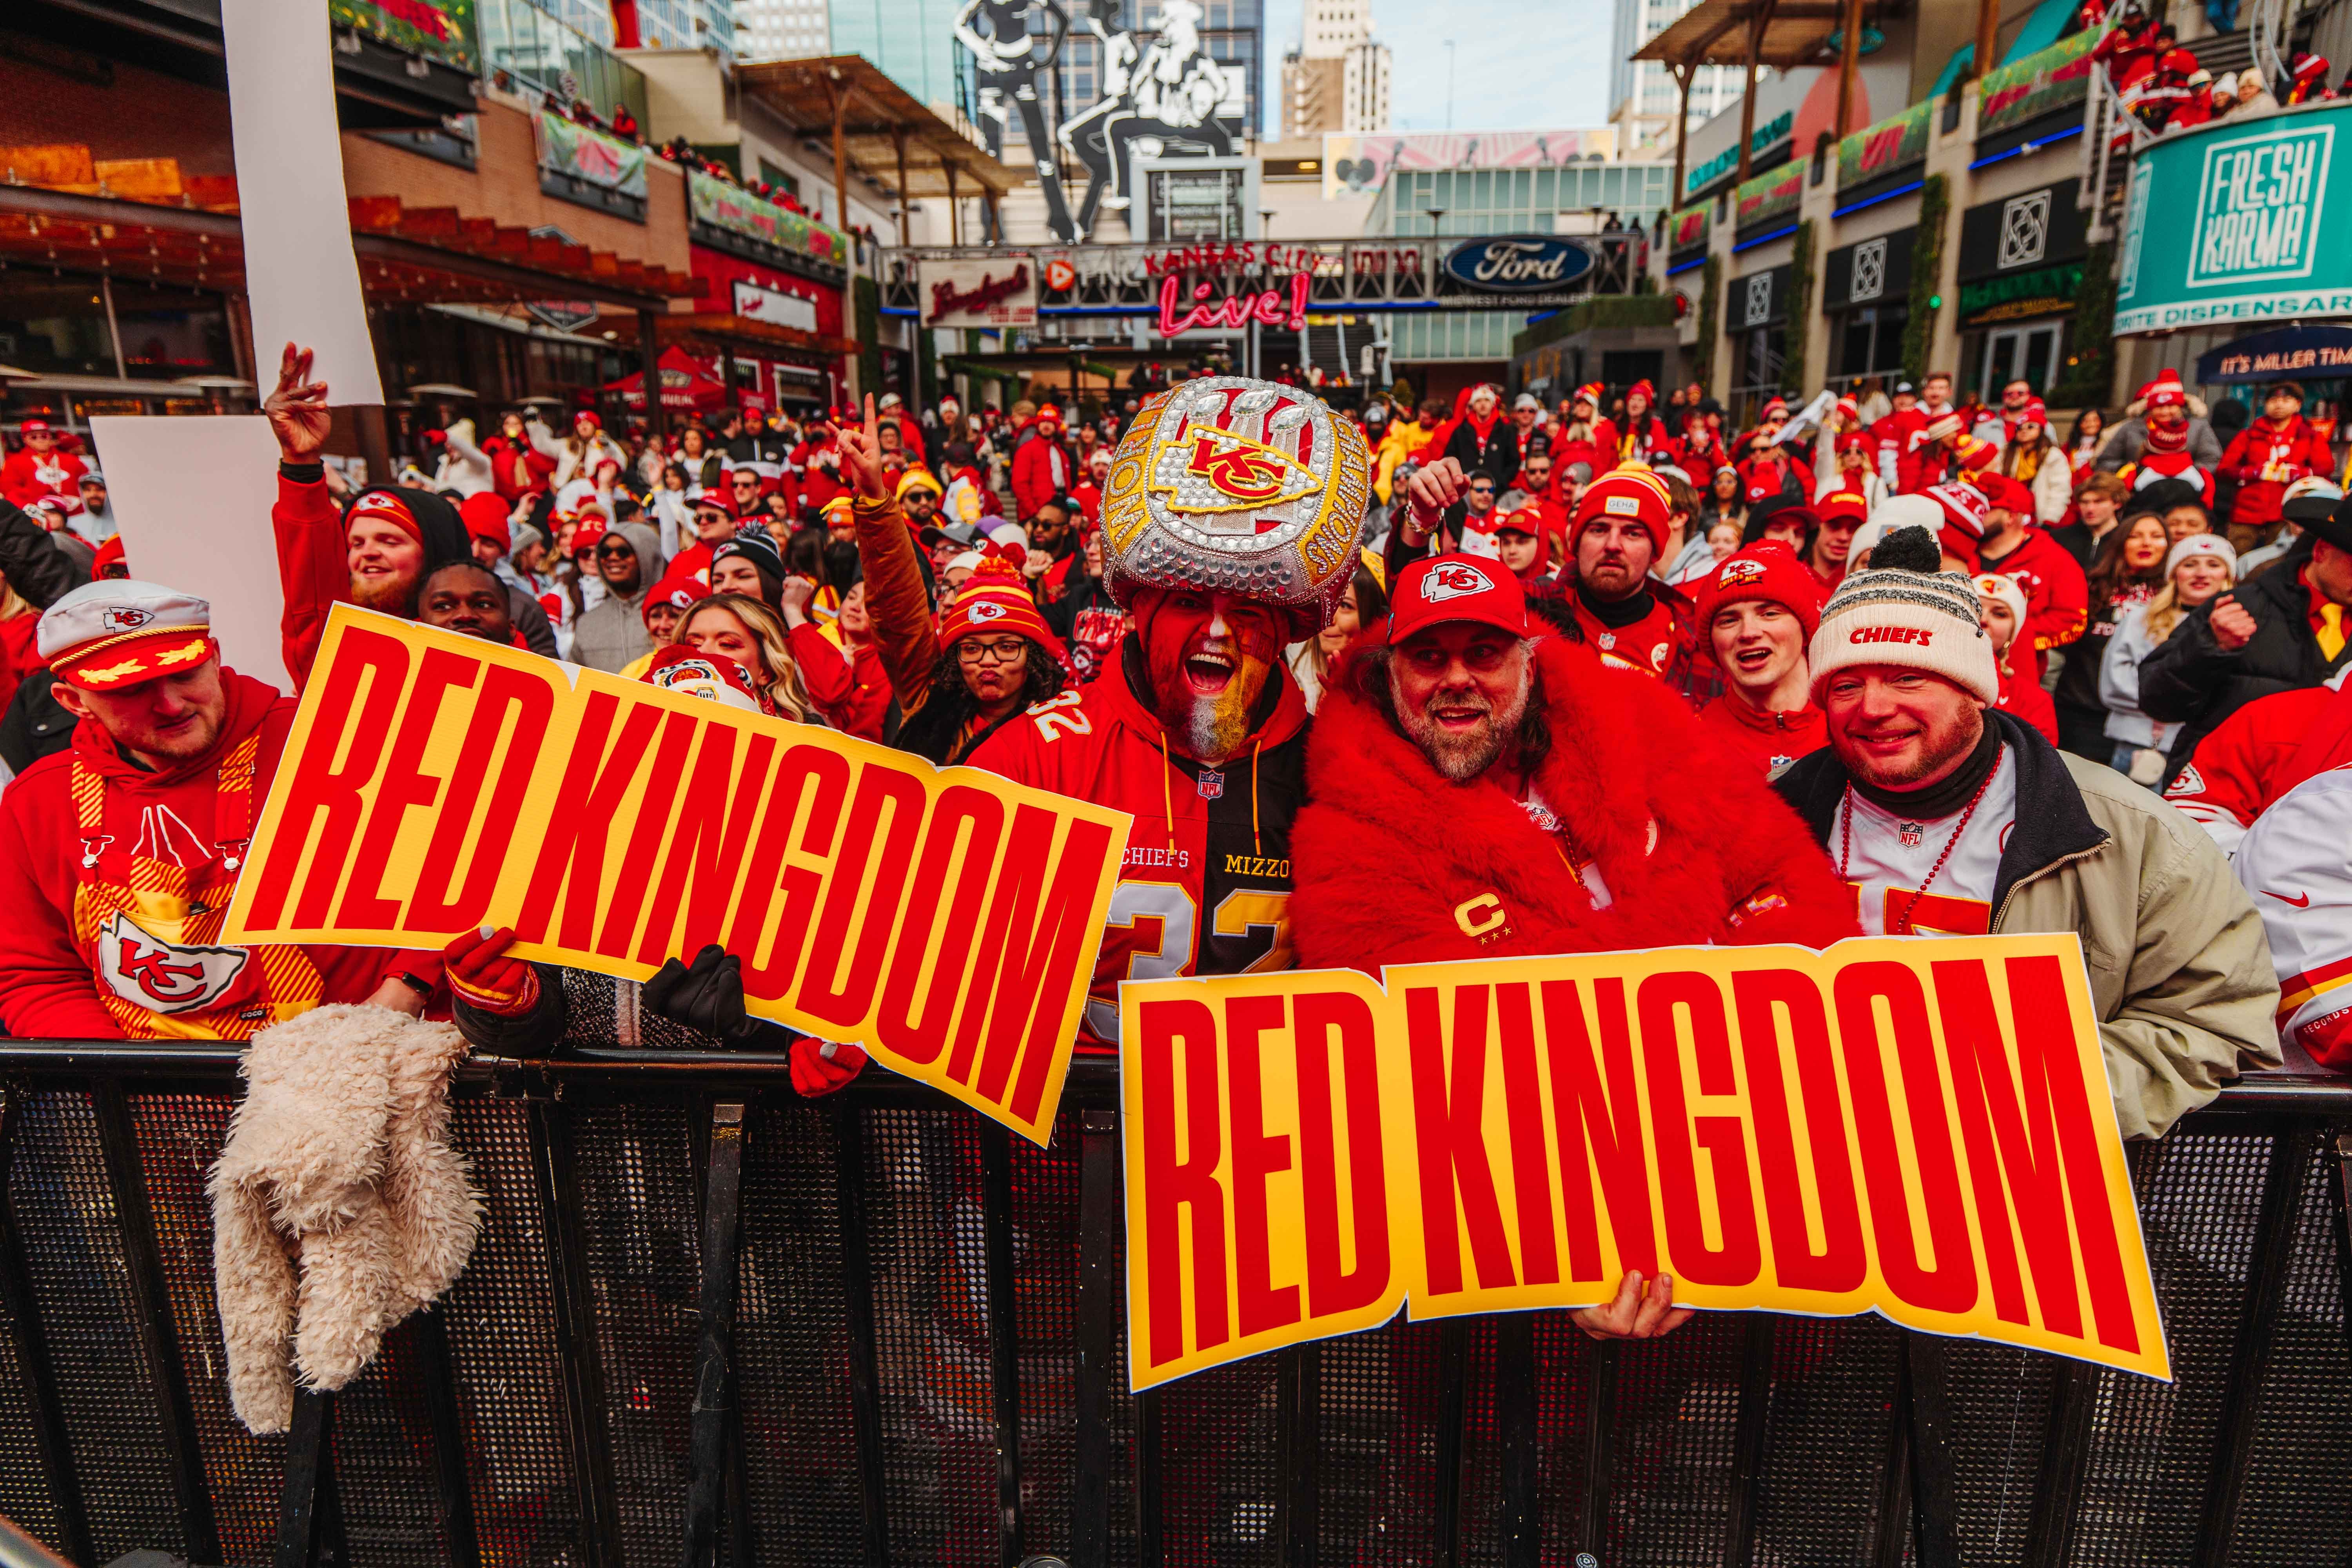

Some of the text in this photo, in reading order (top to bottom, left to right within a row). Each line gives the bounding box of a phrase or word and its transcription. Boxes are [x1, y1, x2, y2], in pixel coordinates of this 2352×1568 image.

[2209, 140, 2317, 214] FRESH
[2200, 203, 2307, 274] KARMA
[1144, 241, 1255, 275] KANSAS
[1475, 241, 1567, 281] Ford
[1159, 270, 1310, 338] Live!
[2165, 295, 2352, 323] DISPENSAR
[2220, 353, 2251, 375] IT'S
[2252, 349, 2316, 372] MILLER
[1188, 437, 1287, 500] KC
[1306, 417, 1366, 575] CHAMPIONS
[1609, 500, 1637, 509] GEHA
[1437, 569, 1478, 590] KC
[113, 611, 144, 626] KC
[1850, 627, 1933, 646] CHIEFS
[1025, 690, 1093, 743] 32
[1201, 782, 1220, 797] NFL
[1534, 814, 1552, 824] NFL
[1900, 832, 1920, 846] NFL
[1121, 847, 1189, 869] CHIEFS
[243, 626, 1113, 1126] RED KINGDOM
[1454, 893, 1506, 937] C
[118, 938, 207, 1003] KC
[241, 1011, 263, 1019] FOCO
[2304, 1008, 2350, 1035] RECORDS
[1139, 955, 2142, 1368] RED KINGDOM
